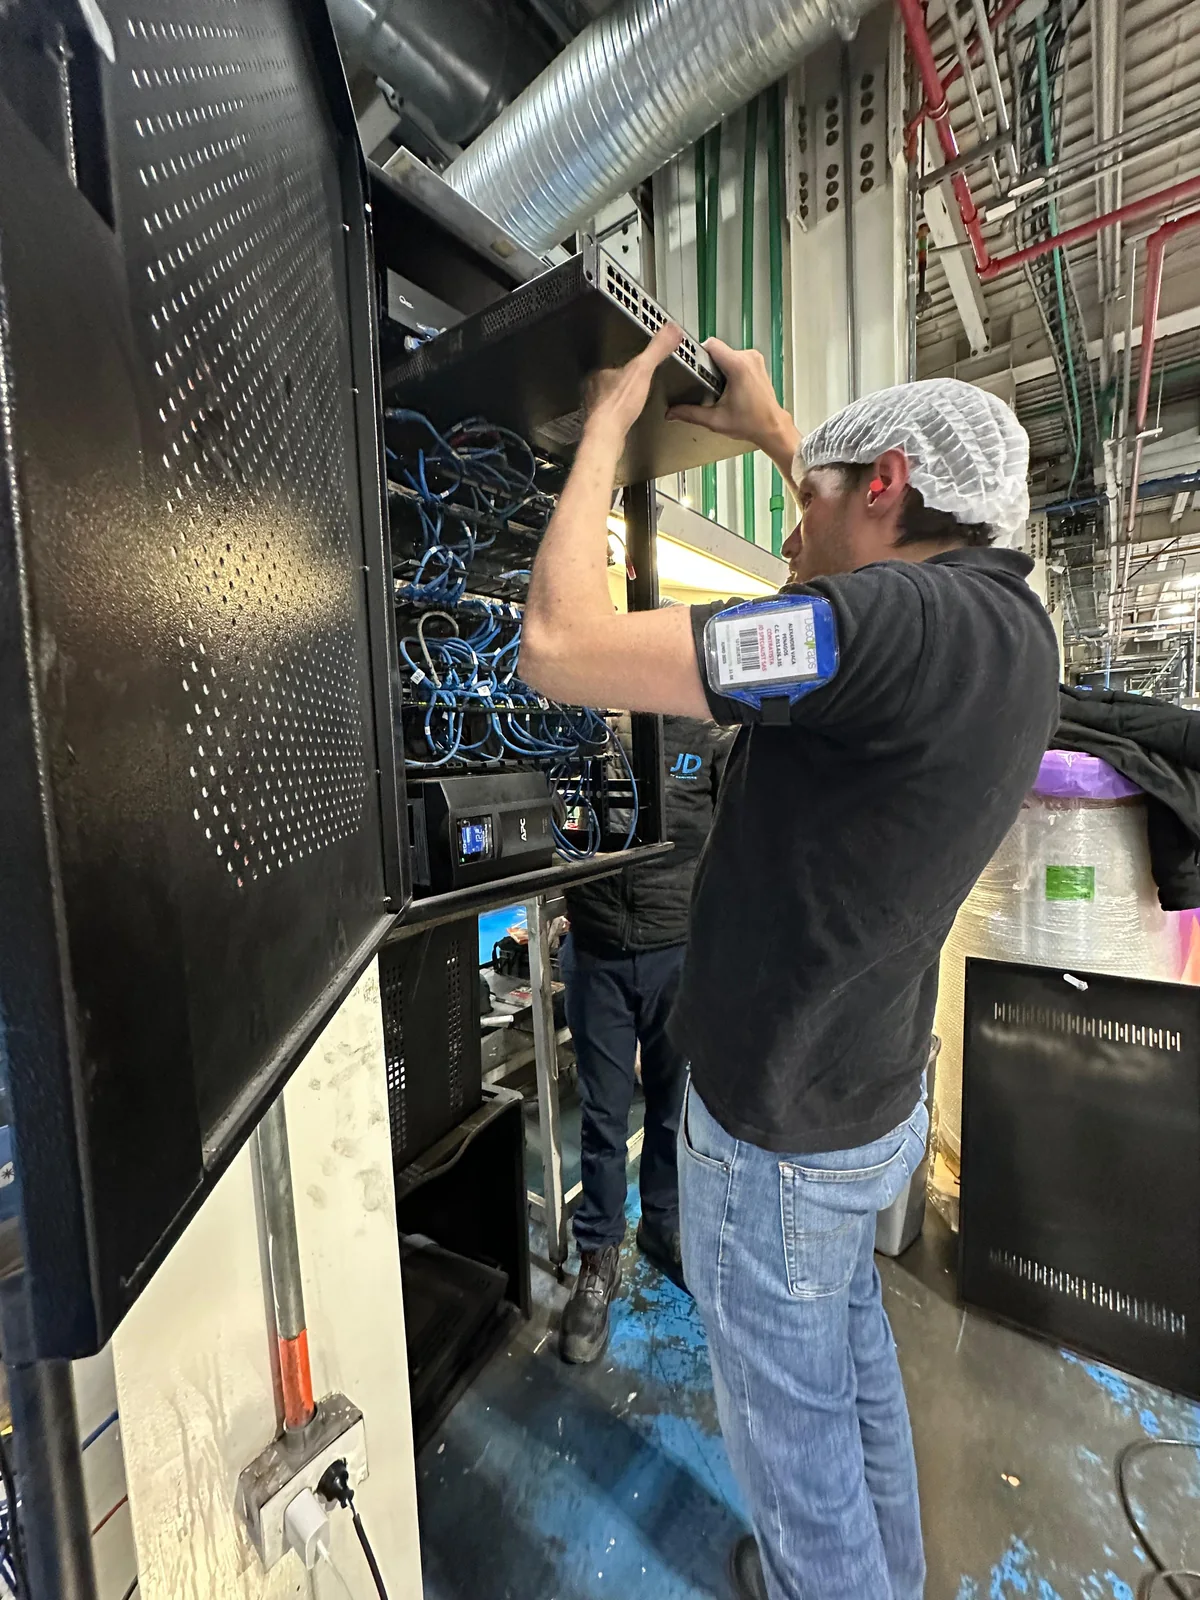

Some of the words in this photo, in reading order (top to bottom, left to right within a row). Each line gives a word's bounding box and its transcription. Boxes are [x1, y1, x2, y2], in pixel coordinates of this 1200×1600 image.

[759, 632, 767, 660] SPECIALIST
[766, 628, 774, 665] CONTRATISTA
[670, 753, 702, 773] JD
